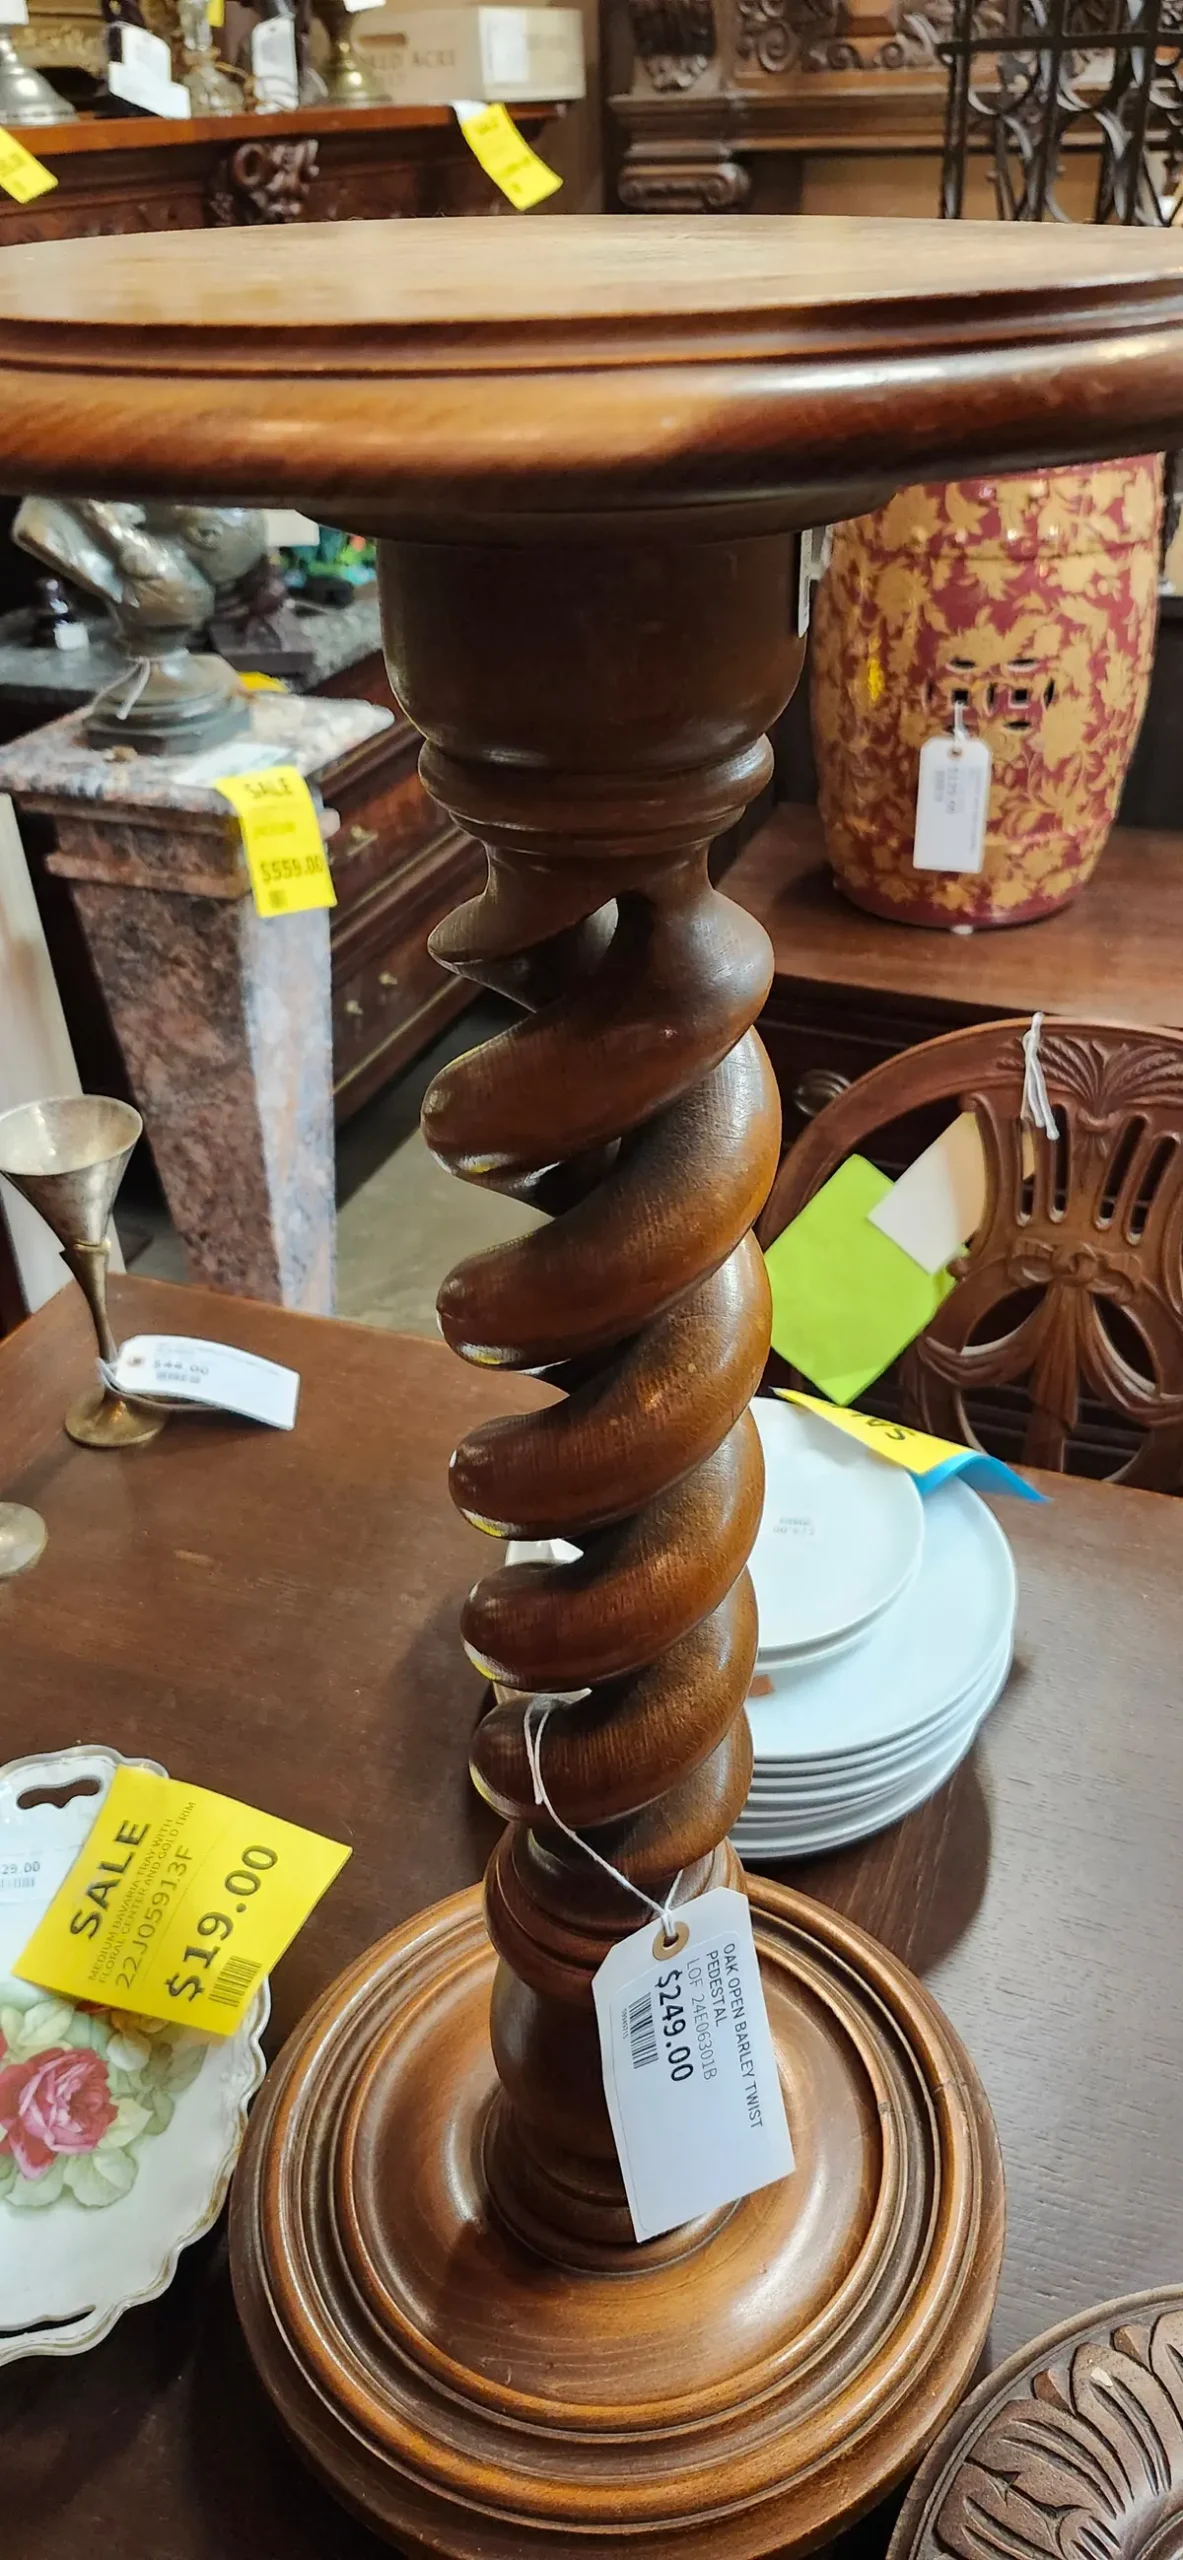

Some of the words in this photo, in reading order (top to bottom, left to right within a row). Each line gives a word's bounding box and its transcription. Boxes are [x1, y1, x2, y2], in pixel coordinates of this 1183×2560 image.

[70, 1819, 151, 1940] SALE
[88, 1931, 115, 1981] MEDIUM
[112, 1879, 141, 1930] BAVARIA
[137, 1849, 158, 1877] TRAY
[152, 1819, 173, 1848] WITH
[99, 1938, 125, 1984] FLORAL
[121, 1887, 147, 1935] CENTER
[143, 1861, 161, 1887] AND
[158, 1829, 180, 1860] GOLD
[175, 1802, 196, 1828] TRIM
[163, 1845, 278, 2002] $19.00
[723, 1943, 739, 1975] OAK
[686, 1957, 703, 1987] LOF
[706, 1950, 729, 2027] PEDESTAL
[727, 1979, 746, 2018] OPEN
[655, 1969, 694, 2082] $249.00
[691, 1994, 718, 2081] 24E06301B
[735, 2021, 756, 2078] BARLEY
[745, 2080, 763, 2129] TWIST
